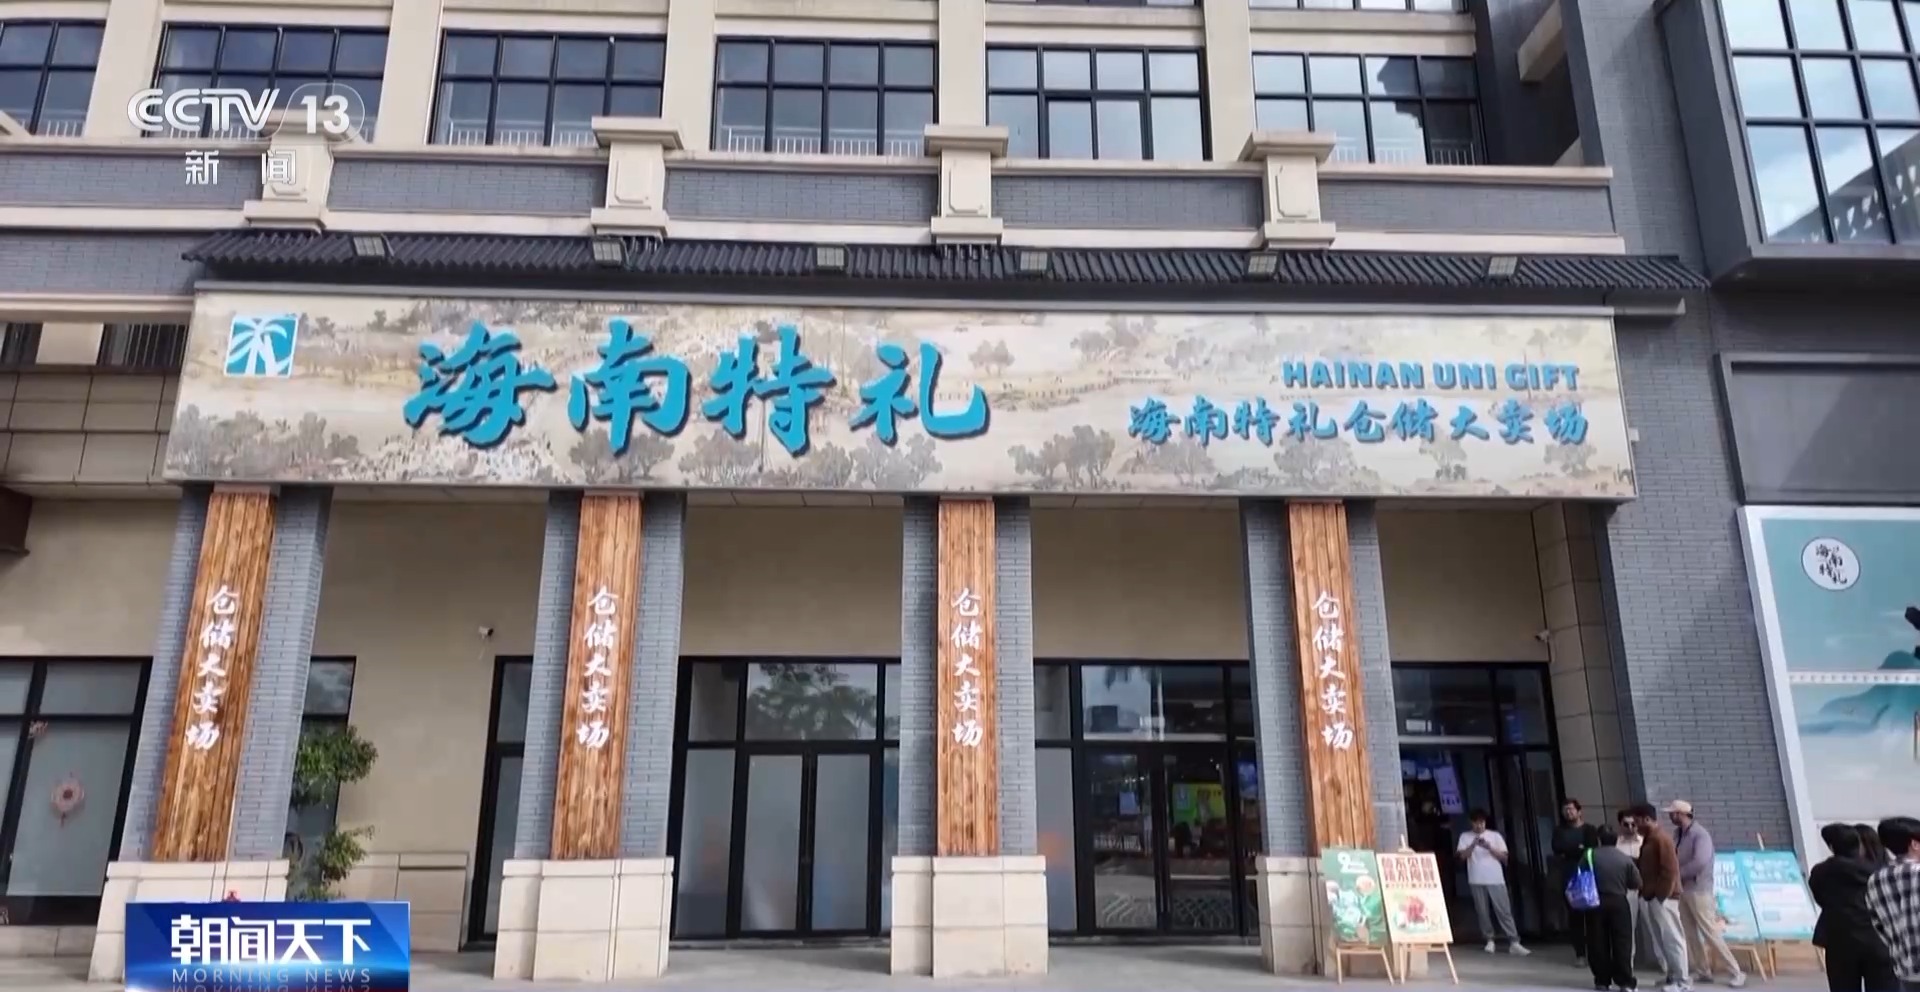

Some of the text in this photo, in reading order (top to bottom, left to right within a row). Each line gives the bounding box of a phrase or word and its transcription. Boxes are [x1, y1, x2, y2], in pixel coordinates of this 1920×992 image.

[403, 319, 990, 457] 海南特礼
[1127, 395, 1590, 447] 海南特礼仓储大卖场
[1282, 359, 1581, 392] HAINAN UNI GIFT
[185, 584, 240, 750] 仓储大卖场
[576, 585, 619, 748] 仓储大卖场
[950, 587, 984, 748] 仓储大卖场
[1311, 590, 1354, 750] 仓储大卖场
